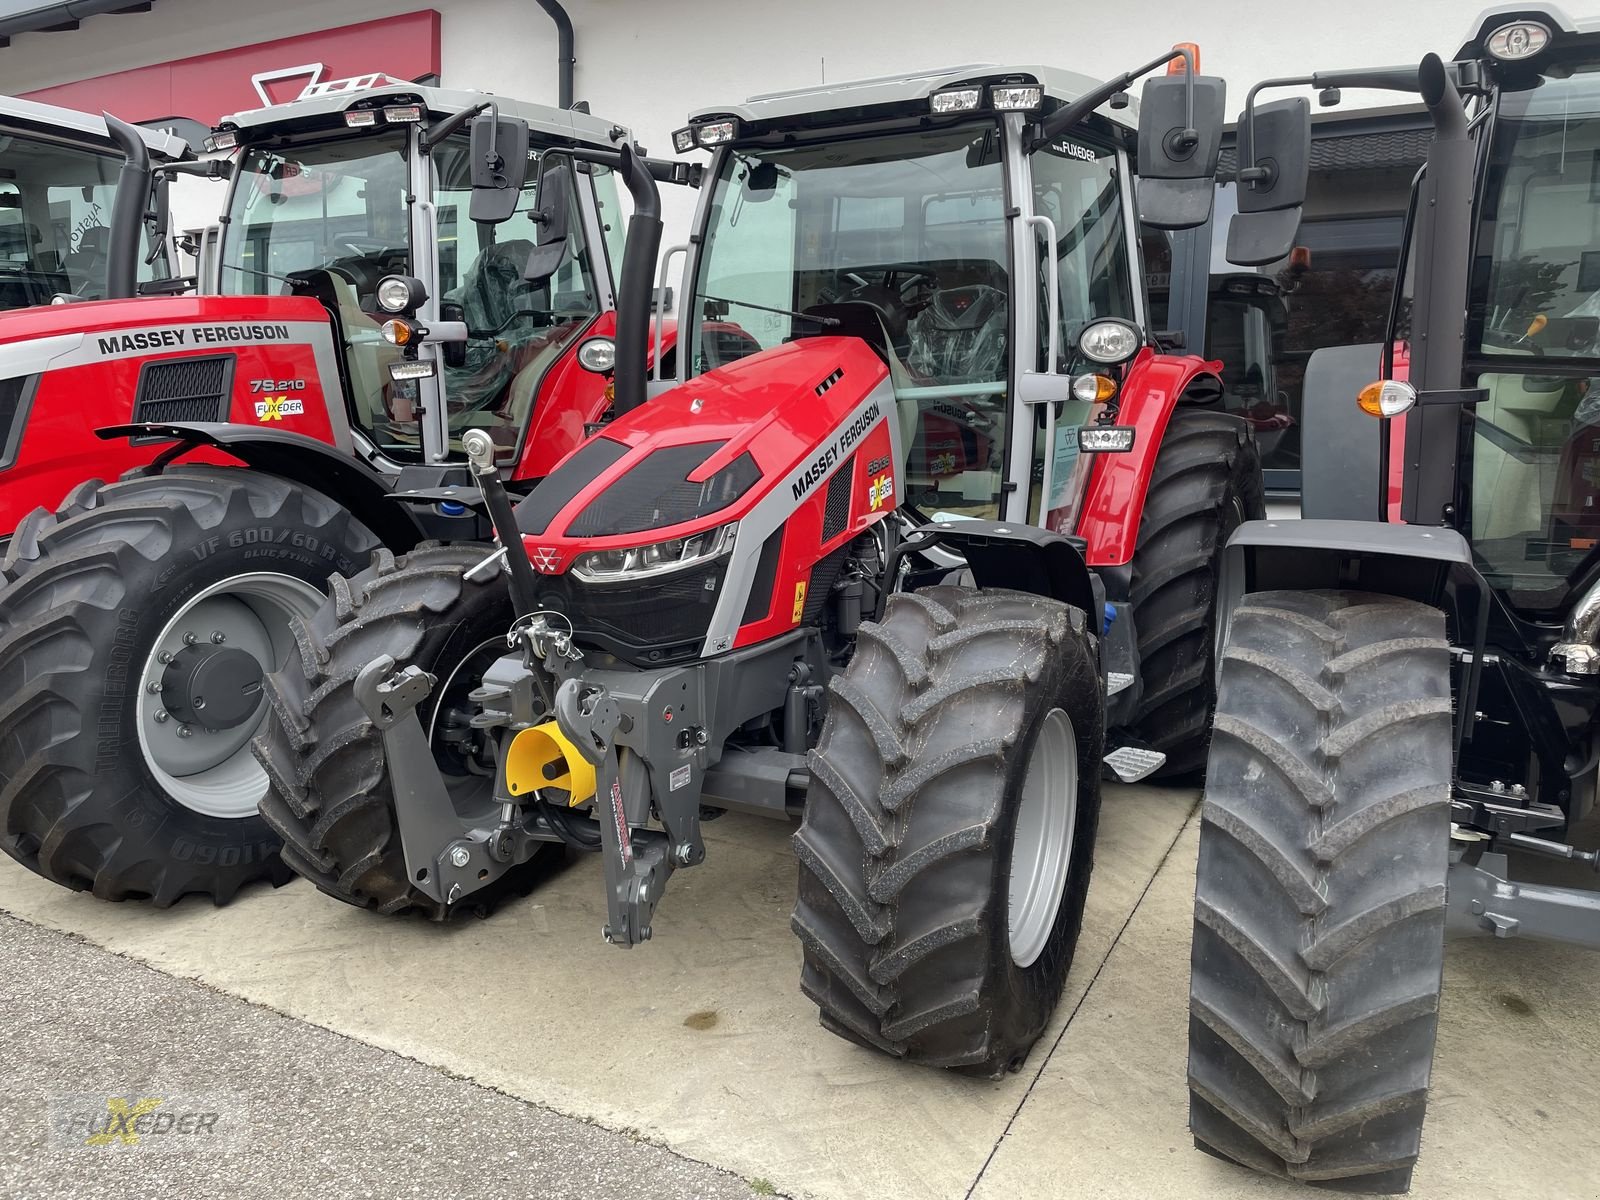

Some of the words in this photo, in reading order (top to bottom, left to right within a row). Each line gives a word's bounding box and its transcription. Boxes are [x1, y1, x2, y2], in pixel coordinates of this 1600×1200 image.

[98, 329, 185, 355] MASSEY
[192, 325, 290, 344] FERGUSON
[250, 379, 306, 393] 7S.210
[791, 442, 838, 501] MASSEY
[839, 400, 880, 453] FERGUSON
[191, 535, 220, 561] VF
[228, 526, 319, 552] 600/60
[95, 607, 140, 776] TRELLEBORG
